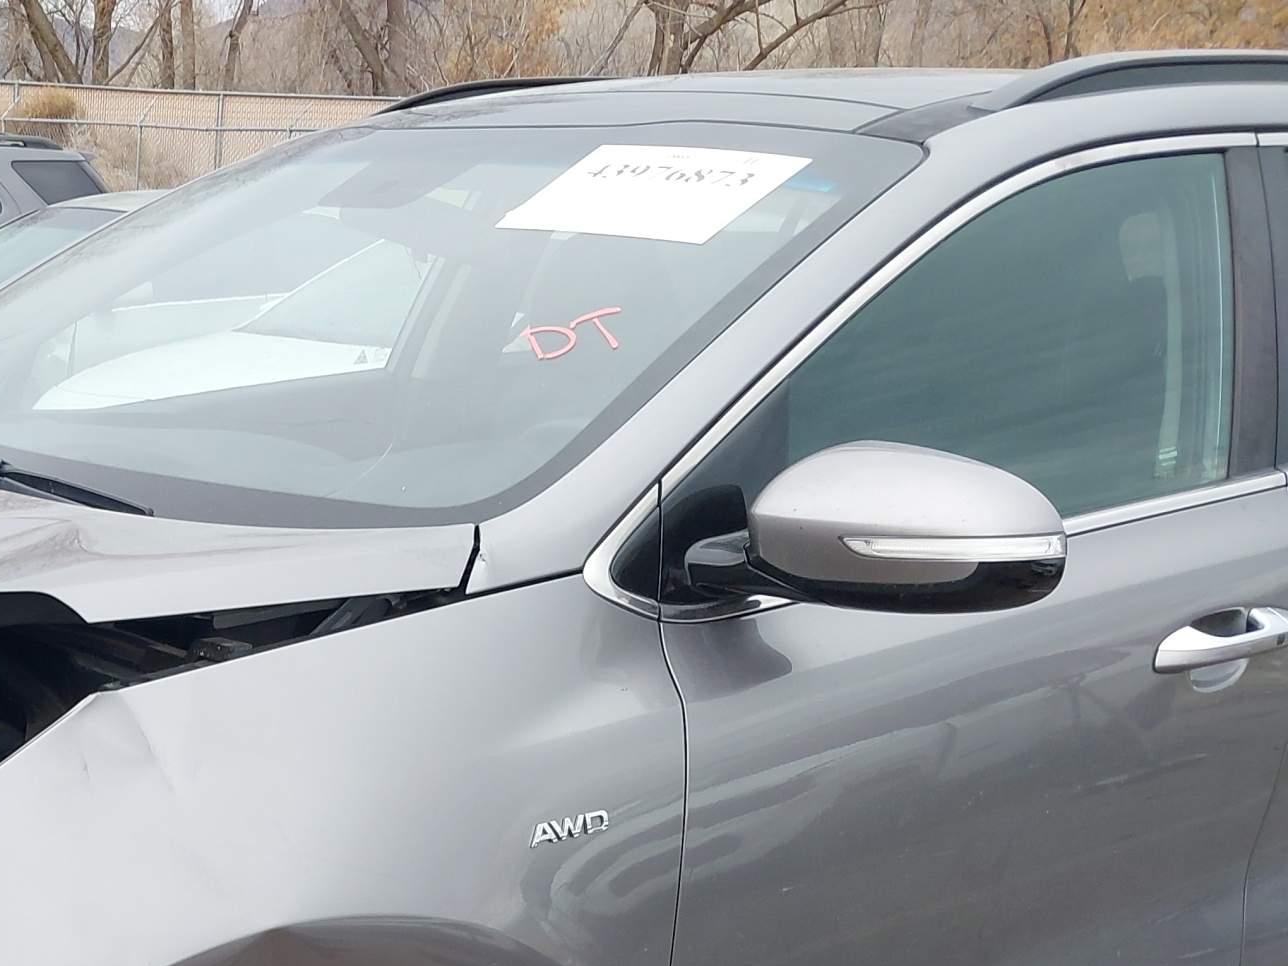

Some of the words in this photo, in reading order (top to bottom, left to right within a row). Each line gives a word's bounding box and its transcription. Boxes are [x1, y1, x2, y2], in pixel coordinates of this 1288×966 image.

[586, 163, 756, 187] 43976873
[520, 306, 622, 360] DT
[529, 809, 610, 848] AWD
